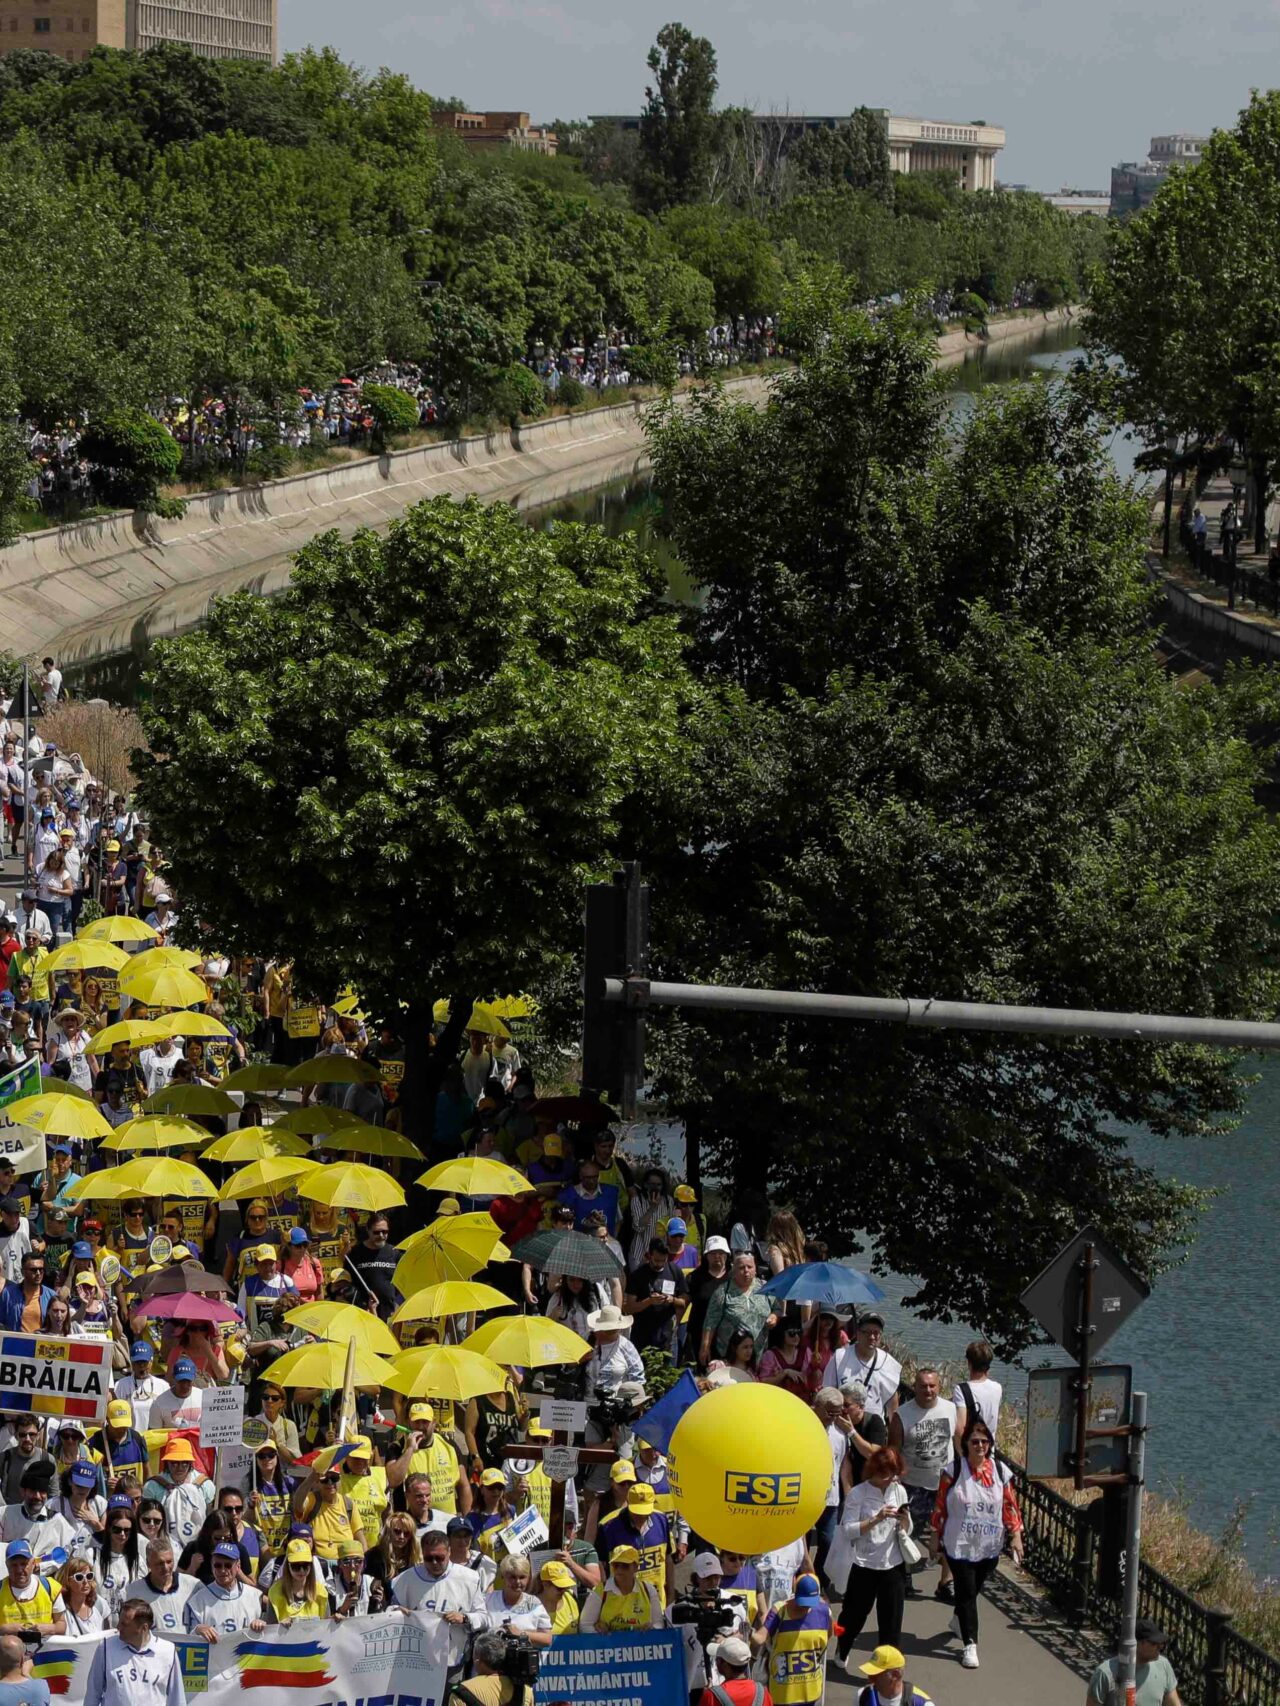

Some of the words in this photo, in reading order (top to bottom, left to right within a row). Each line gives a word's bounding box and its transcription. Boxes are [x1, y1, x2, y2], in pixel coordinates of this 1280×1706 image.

[362, 1262, 392, 1270] MONTEGO
[0, 1361, 101, 1395] BRĂILA
[80, 1467, 93, 1477] FSLI
[228, 1460, 253, 1469] SECTO
[727, 1474, 800, 1504] FSE
[727, 1505, 759, 1518] Spiru
[569, 1643, 673, 1665] INDEPENDENT
[116, 1667, 161, 1687] FSLI
